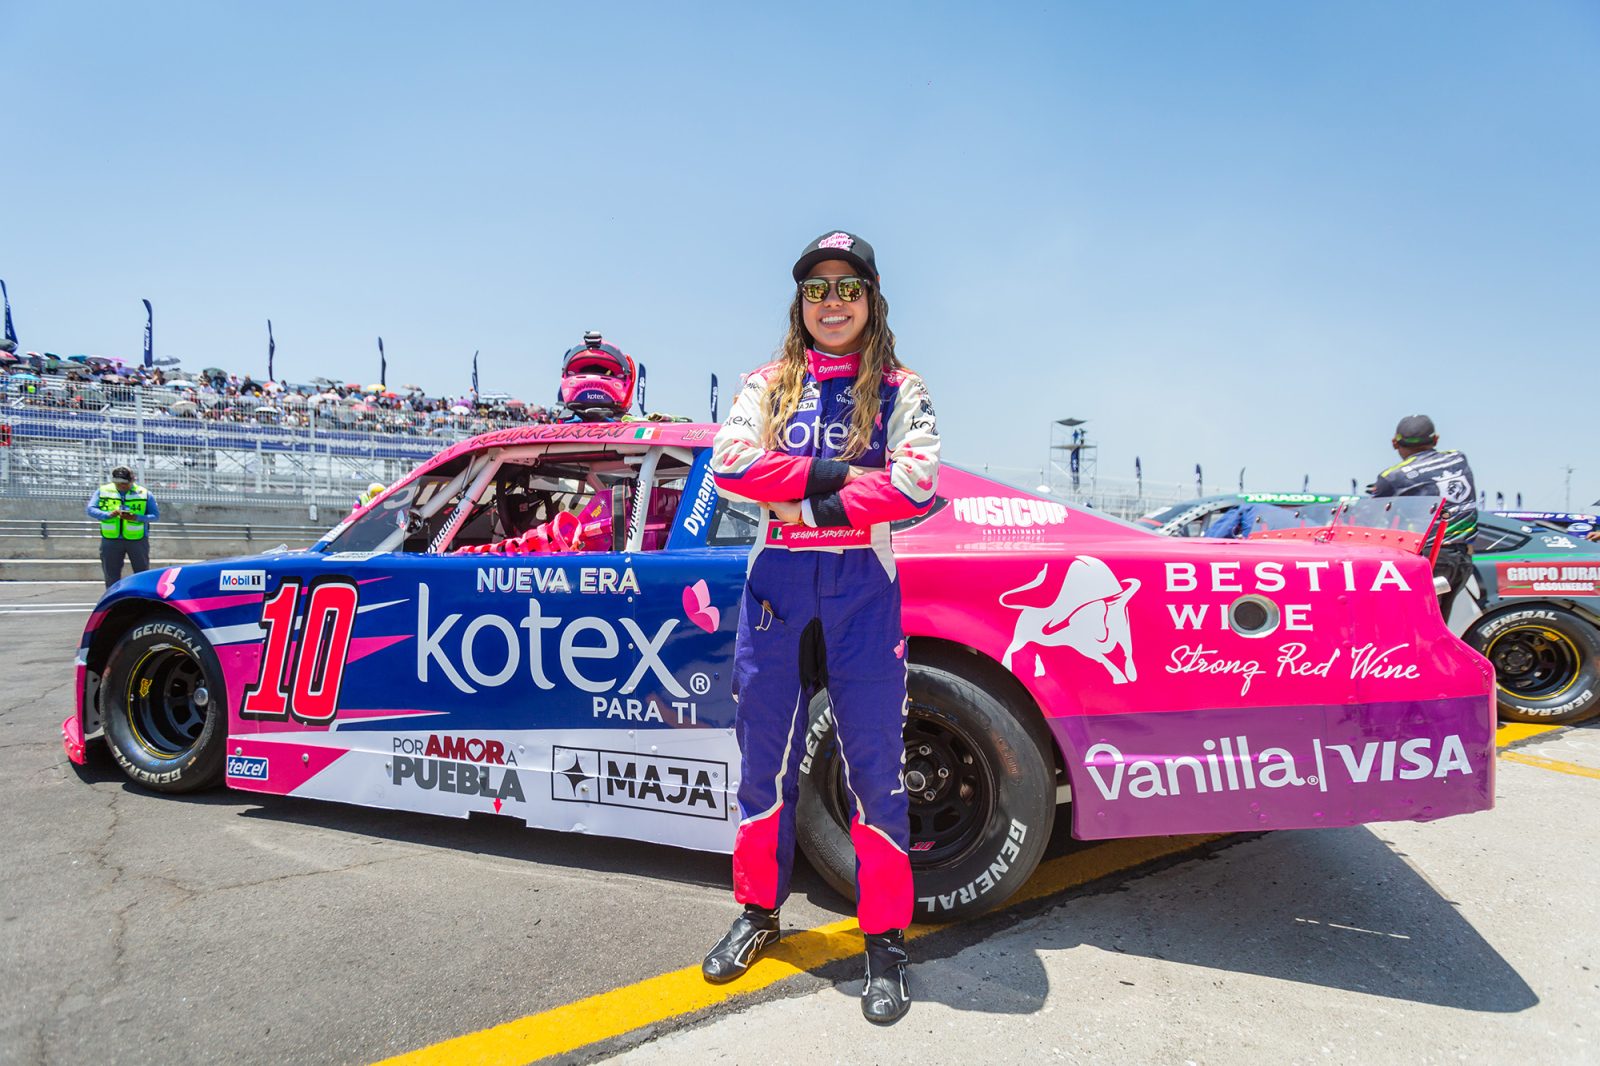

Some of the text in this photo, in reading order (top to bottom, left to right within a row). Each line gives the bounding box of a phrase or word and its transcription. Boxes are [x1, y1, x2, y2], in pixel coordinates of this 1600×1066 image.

[818, 362, 852, 374] Dynamic
[778, 415, 873, 452] ote
[683, 463, 715, 537] Dynami
[222, 575, 261, 586] Mobil 1
[477, 568, 641, 594] NUEVA ERA
[1165, 561, 1411, 592] BESTIA
[1506, 567, 1558, 580] GRUPO
[1166, 604, 1314, 631] WIE
[1481, 610, 1558, 638] GENERAL
[132, 622, 203, 660] GENERAL
[242, 577, 359, 723] 10
[417, 582, 691, 698] kotex
[1165, 642, 1420, 696] Strong Red Wine
[592, 697, 697, 725] PARA TI
[1516, 689, 1593, 716] GENERAL
[113, 744, 183, 784] GENERAL
[393, 734, 518, 766] POR AMOR A
[1084, 735, 1306, 800] Vanilla
[1325, 734, 1473, 782] VISA
[228, 758, 267, 778] telcel
[393, 755, 526, 802] PUEBLA
[606, 760, 717, 809] MAJA
[917, 819, 1028, 912] GENERAL
